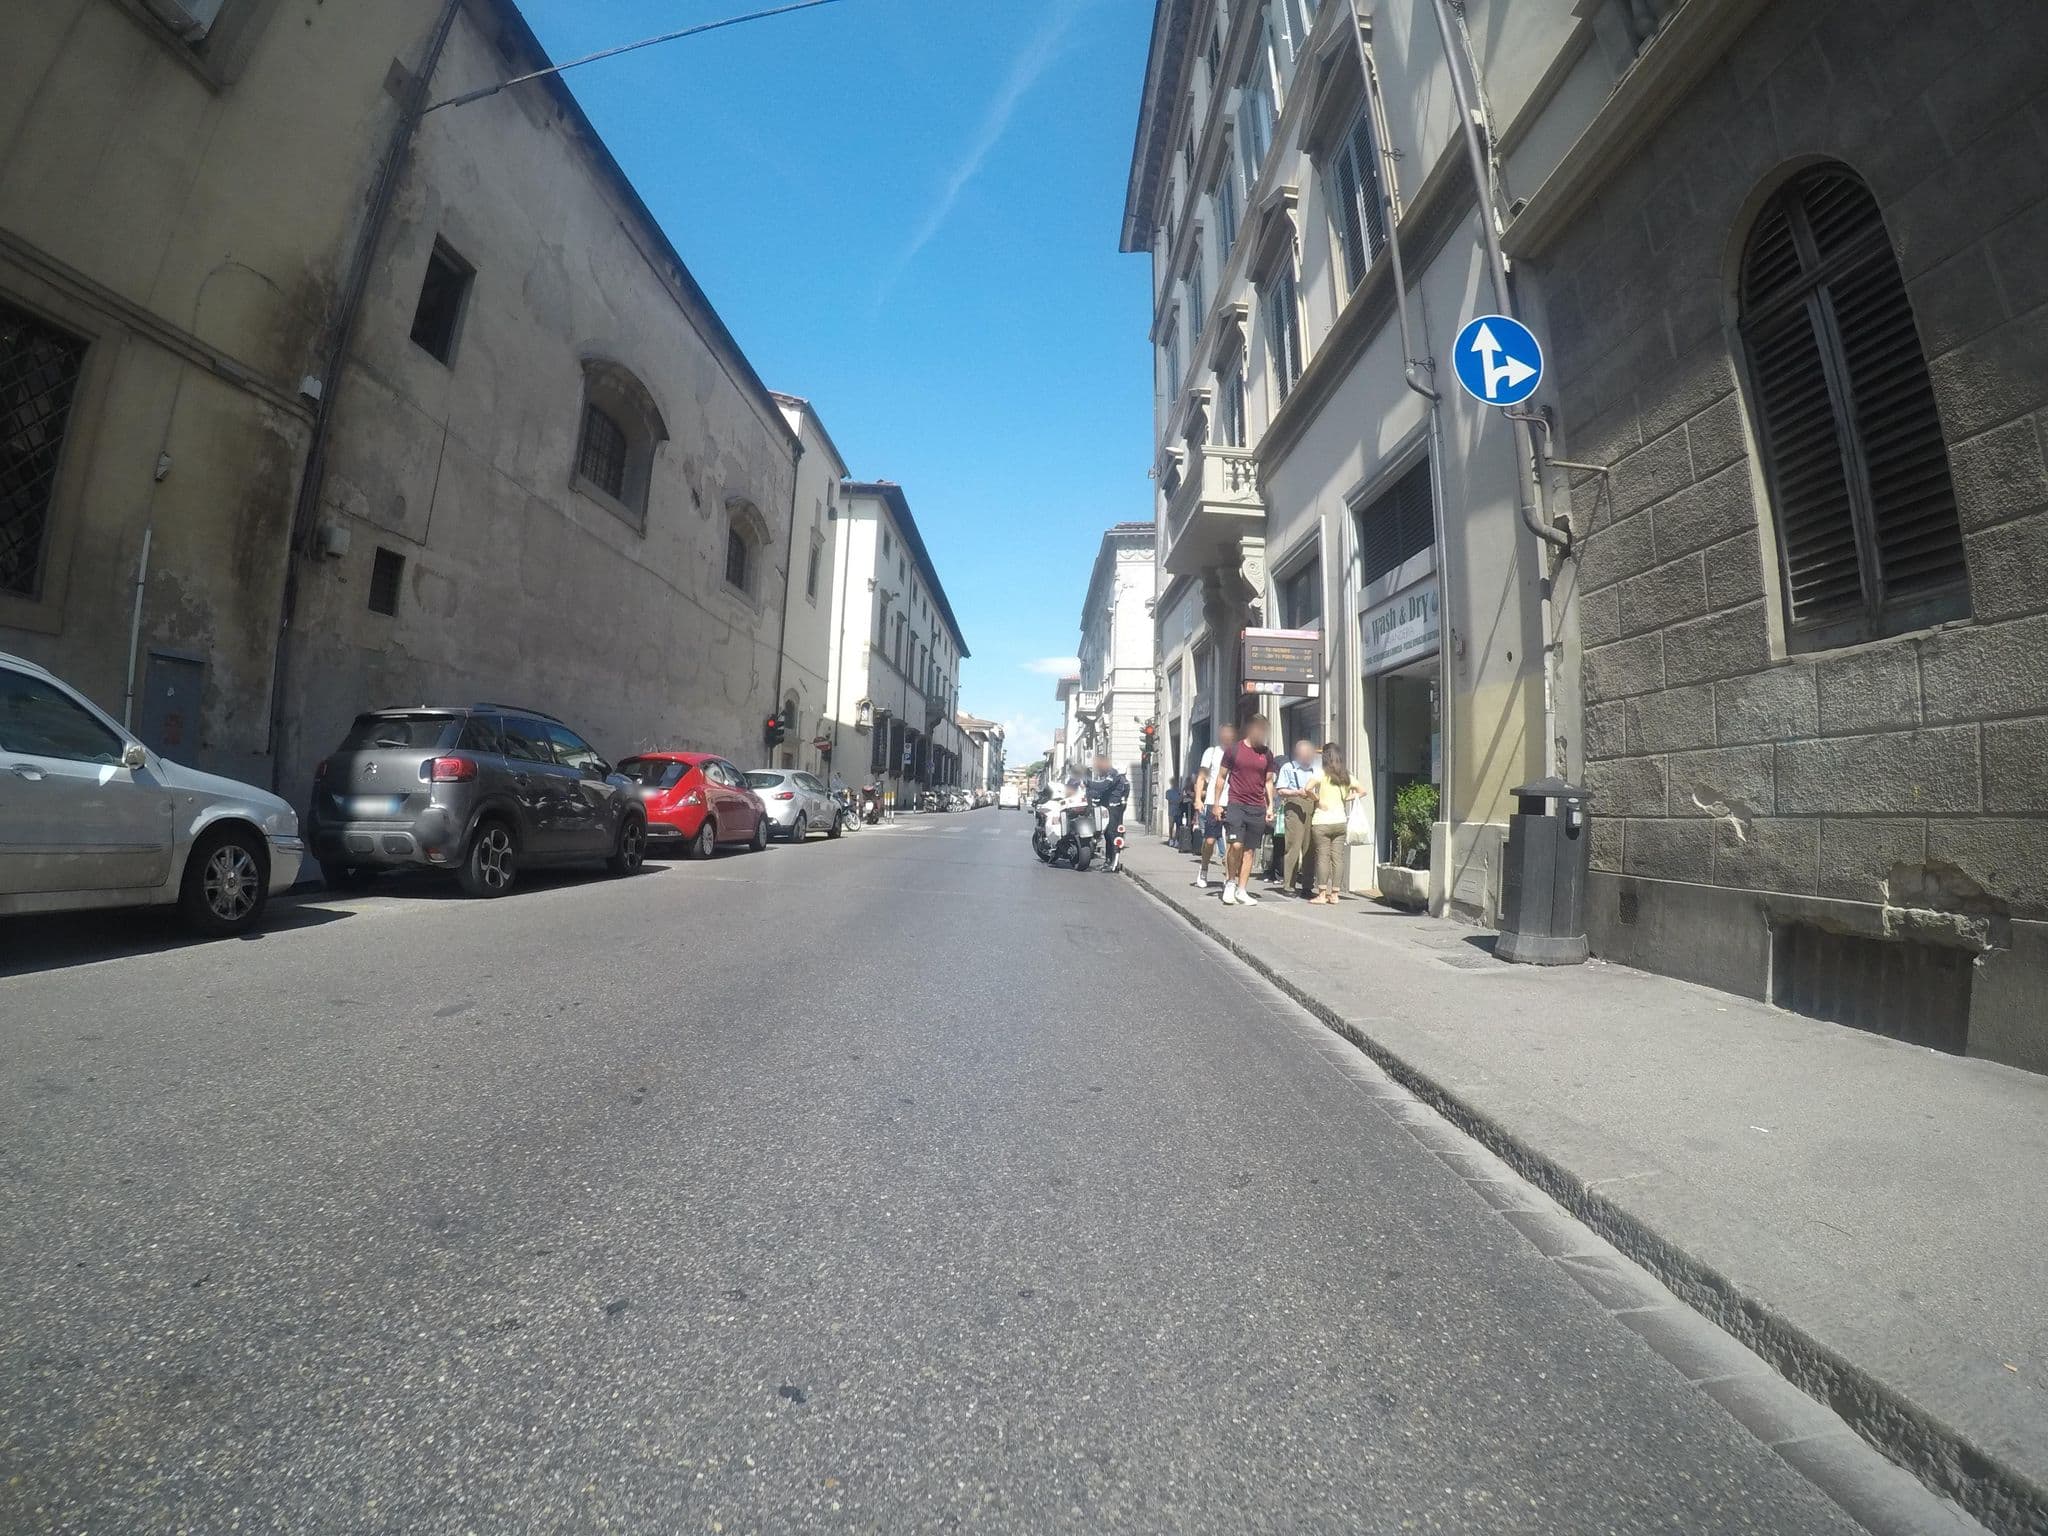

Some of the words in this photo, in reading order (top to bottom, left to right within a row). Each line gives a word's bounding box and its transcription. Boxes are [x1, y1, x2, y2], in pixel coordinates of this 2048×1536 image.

[1371, 607, 1396, 646] Wash
[1399, 606, 1406, 626] &
[1408, 592, 1429, 623] Dry
